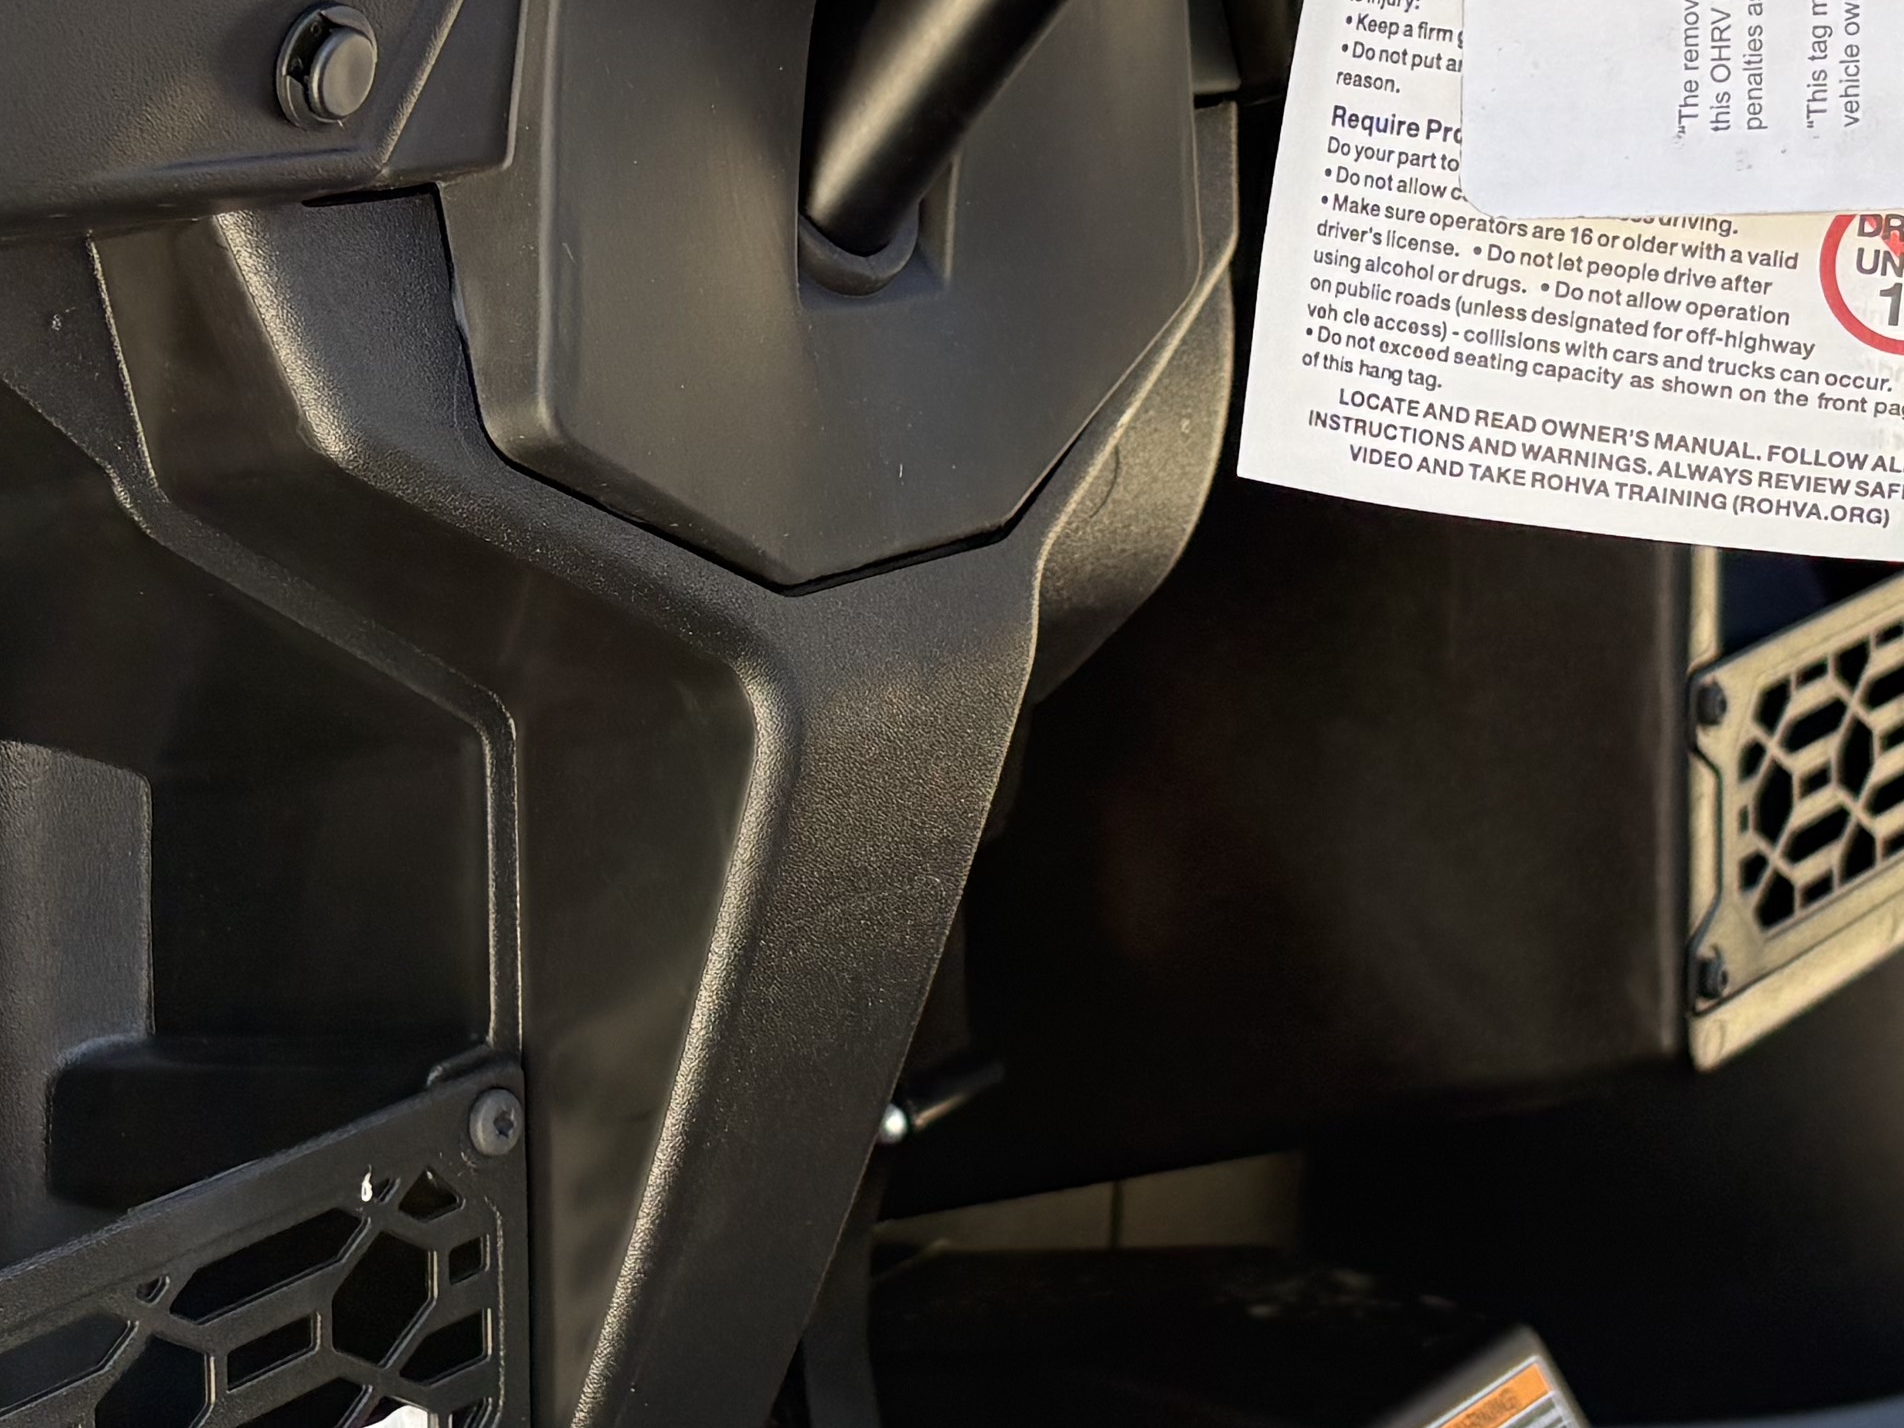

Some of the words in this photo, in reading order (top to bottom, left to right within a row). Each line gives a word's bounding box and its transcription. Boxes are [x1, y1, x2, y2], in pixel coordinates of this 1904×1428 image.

[1335, 70, 1401, 94] reason.
[1710, 6, 1732, 84] OHRV
[1743, 24, 1768, 131] penalties
[1330, 104, 1421, 139] Require
[1709, 90, 1731, 132] this
[1308, 409, 1465, 451] INSTRUCTIONS
[1467, 435, 1517, 458] AND
[1521, 441, 1653, 476] WARNINGS.
[1656, 459, 1753, 486] ALWAYS
[1757, 470, 1852, 496] REVIEW
[1338, 387, 1421, 418] LOCATE
[1421, 401, 1470, 424] AND
[1473, 408, 1537, 433] READ
[1541, 418, 1650, 448] OWNER'S
[1653, 431, 1762, 461] MANUAL.
[1766, 444, 1869, 471] FOLLOW
[1349, 443, 1413, 471] VIDEO
[1415, 455, 1464, 478] AND
[1468, 462, 1527, 487] TAKE
[1530, 470, 1610, 498] ROHVA
[1614, 481, 1727, 510] TRAINING
[1731, 494, 1890, 529] (ROHVA.ORG)
